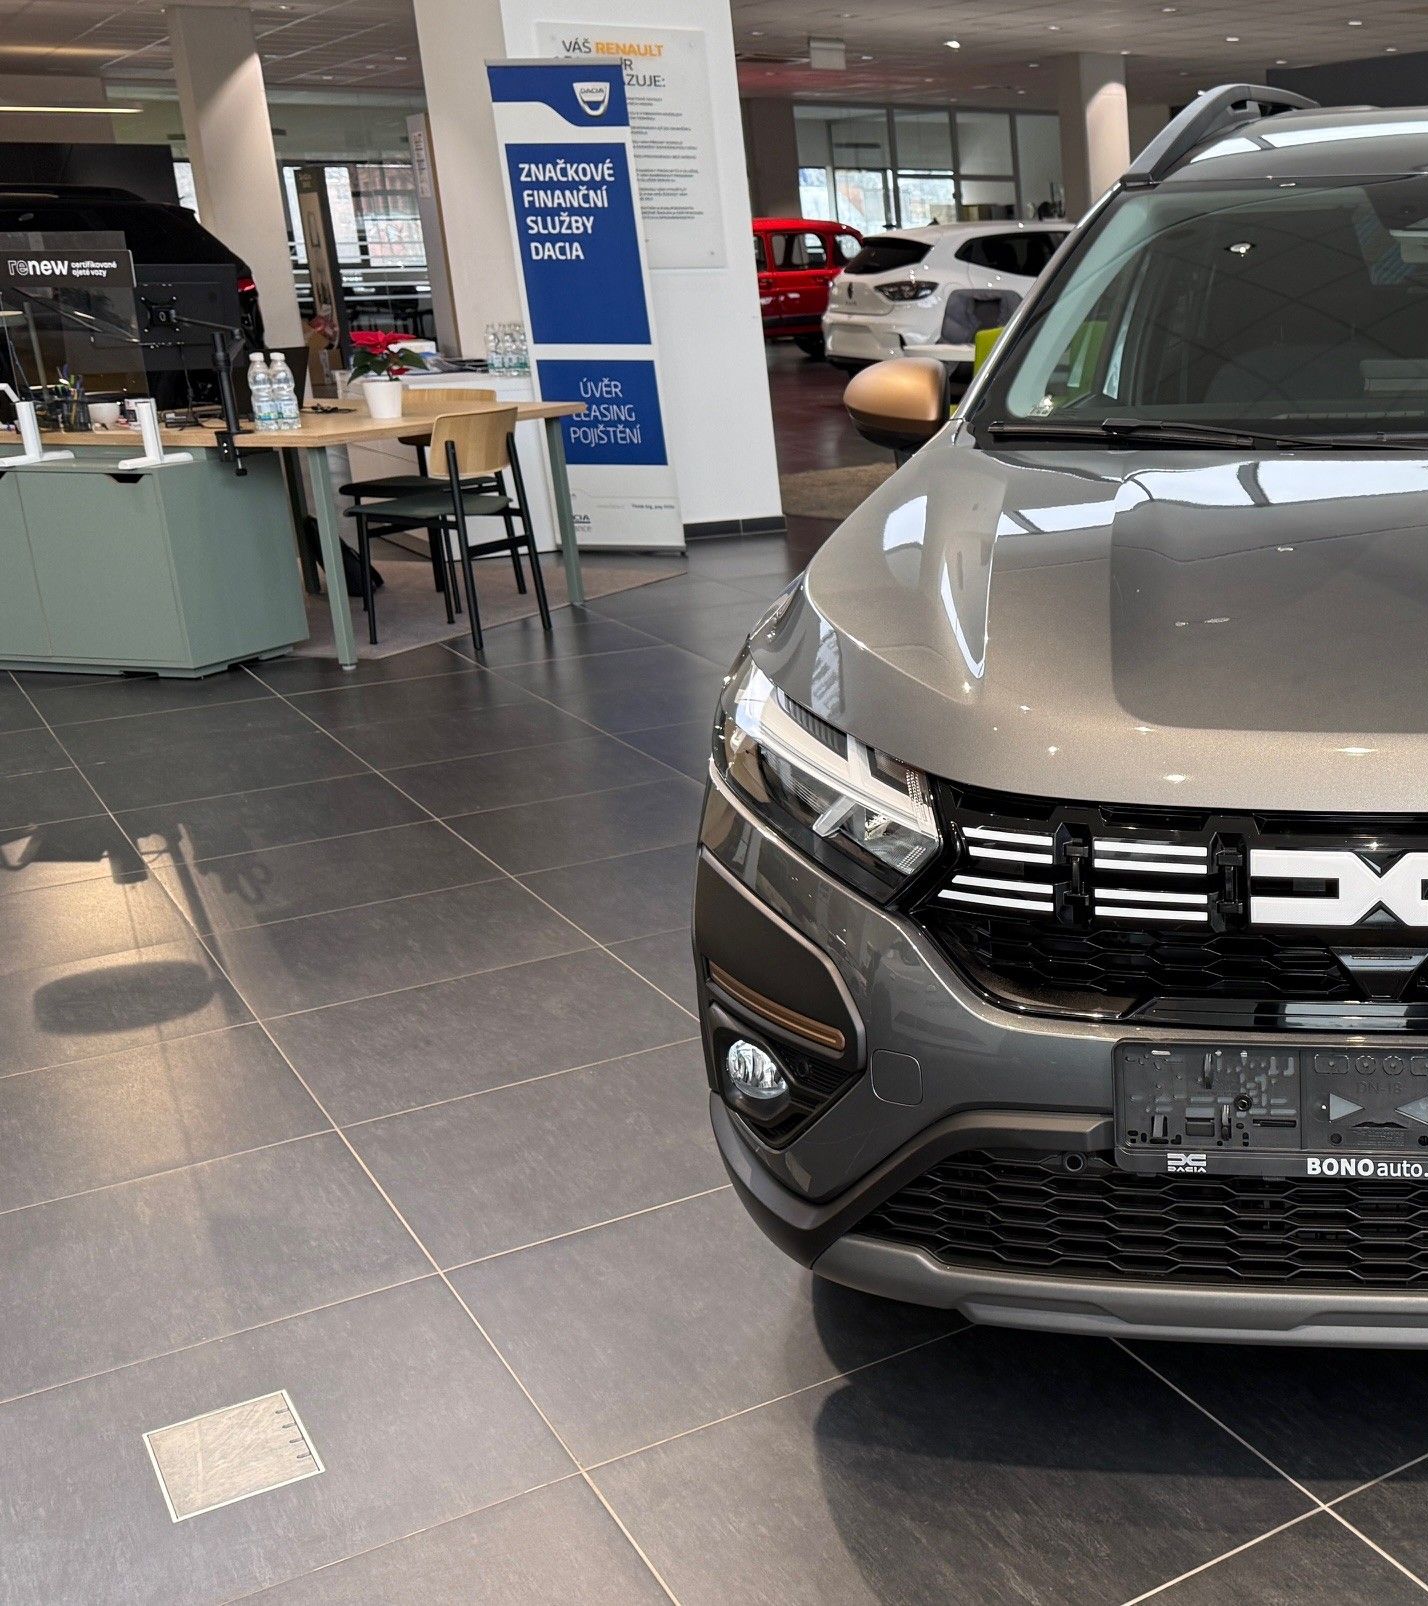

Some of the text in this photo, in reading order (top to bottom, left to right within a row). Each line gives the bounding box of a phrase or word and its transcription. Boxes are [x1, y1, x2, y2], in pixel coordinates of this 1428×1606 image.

[561, 37, 665, 57] VÁŠ RENAULT
[518, 158, 615, 182] ZNAČKOVÉ
[522, 185, 609, 208] FINANČNÍ
[526, 212, 594, 234] SLUŽBY
[530, 242, 585, 260] DACIA
[7, 260, 69, 276] renew
[90, 269, 107, 278] vozy
[579, 377, 623, 398] ÚVĚR
[570, 424, 641, 447] POJIŠTĚNÍ
